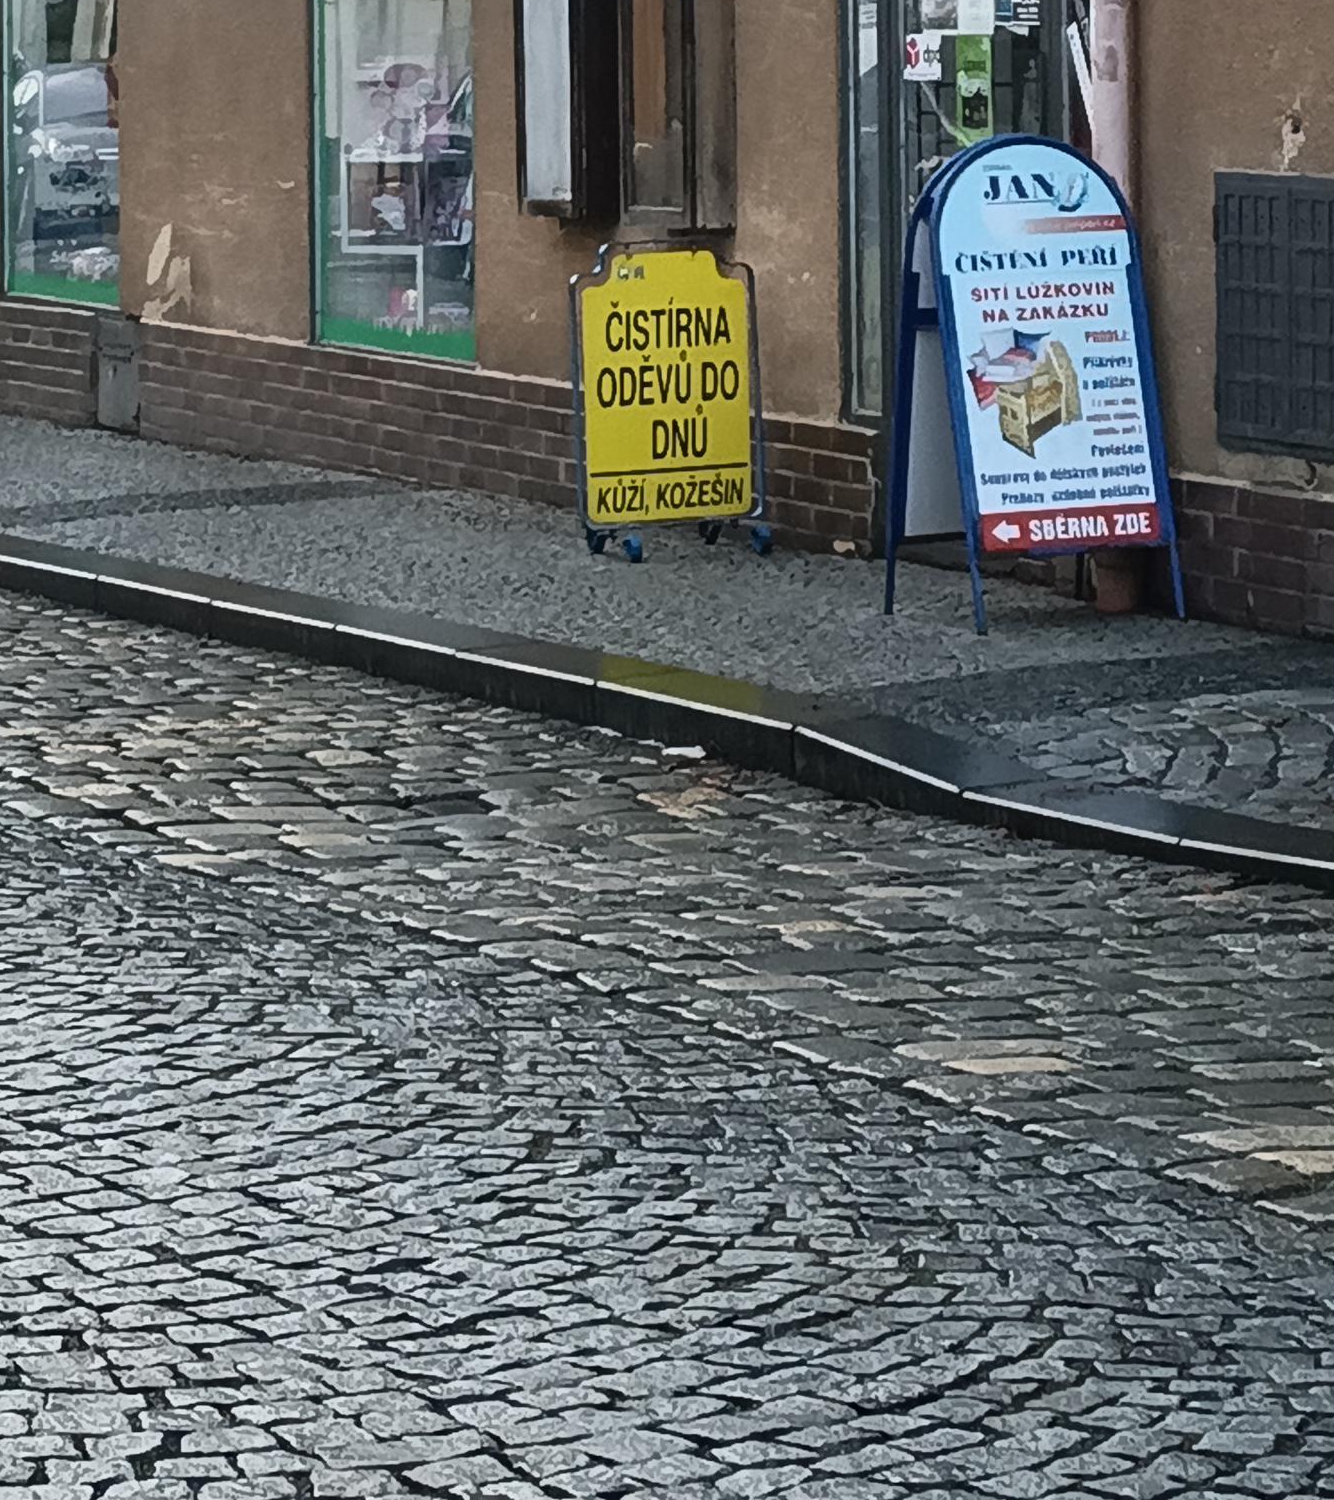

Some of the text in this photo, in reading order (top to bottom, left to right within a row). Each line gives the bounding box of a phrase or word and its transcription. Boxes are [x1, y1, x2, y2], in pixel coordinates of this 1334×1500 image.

[605, 297, 731, 352] ČISTÍRNA
[982, 301, 1109, 323] NA ZAKÁZKU
[597, 350, 740, 408] ODĚVŮ DO
[652, 404, 708, 460] DNŮ
[597, 473, 745, 516] KŮŽÍ, KOŽEŠIN
[1113, 512, 1152, 536] ZDE
